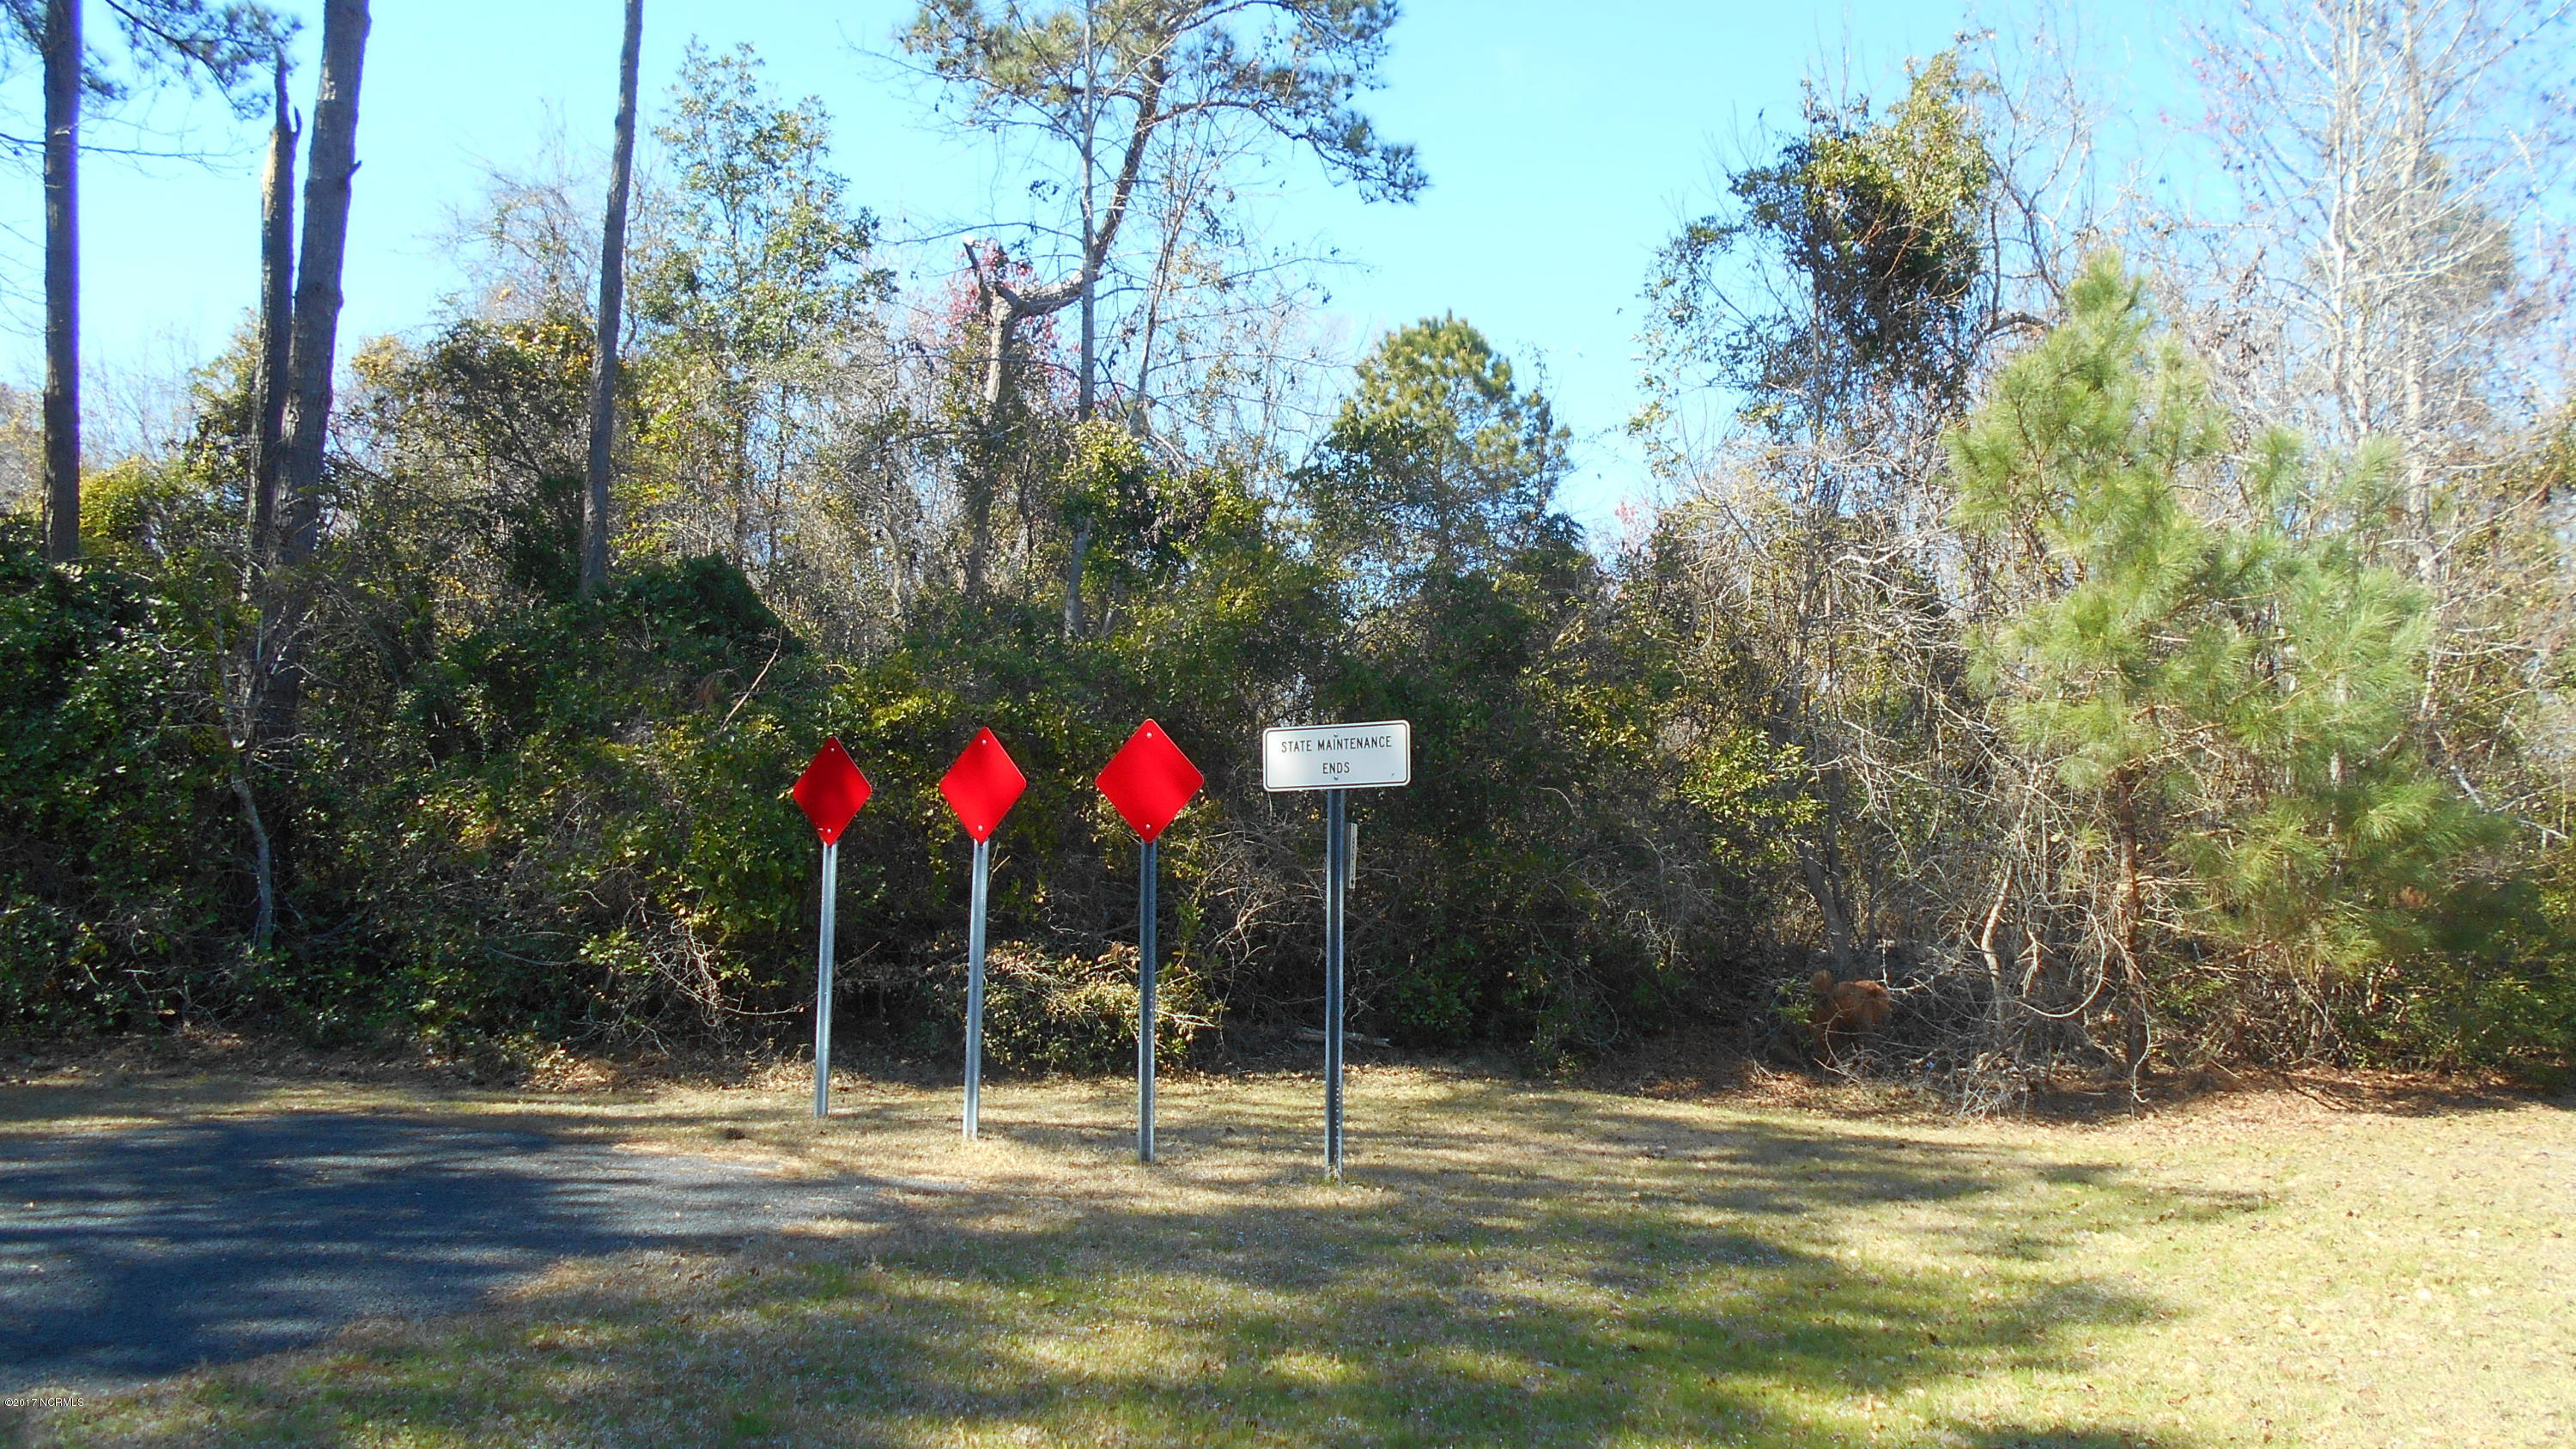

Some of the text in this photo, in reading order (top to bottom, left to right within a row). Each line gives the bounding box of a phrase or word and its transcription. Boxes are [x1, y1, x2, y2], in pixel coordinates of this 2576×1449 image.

[1281, 735, 1392, 752] STATE MAINTENANCE
[1322, 762, 1350, 774] ENDS
